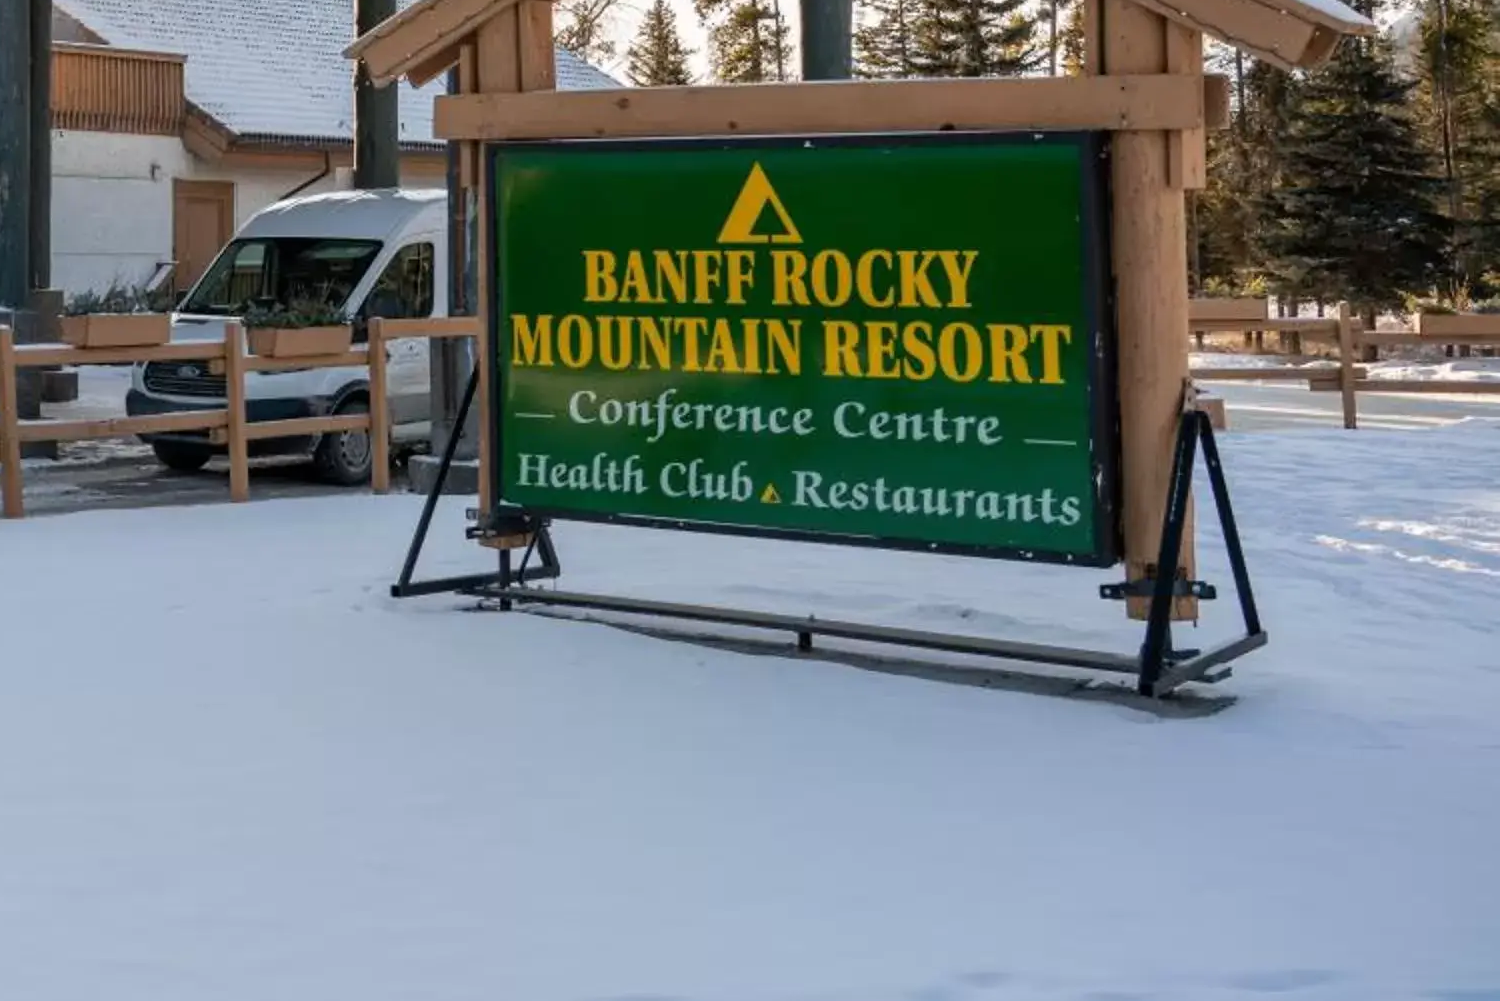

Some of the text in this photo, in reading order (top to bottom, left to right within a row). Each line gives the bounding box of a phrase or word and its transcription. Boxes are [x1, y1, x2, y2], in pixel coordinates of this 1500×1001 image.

[583, 249, 979, 309] BANFF ROCKY
[510, 313, 1073, 385] MOUNTAIN RESORT
[567, 387, 1004, 445] Conference Centre
[515, 452, 1083, 527] Health Club Restaurants
